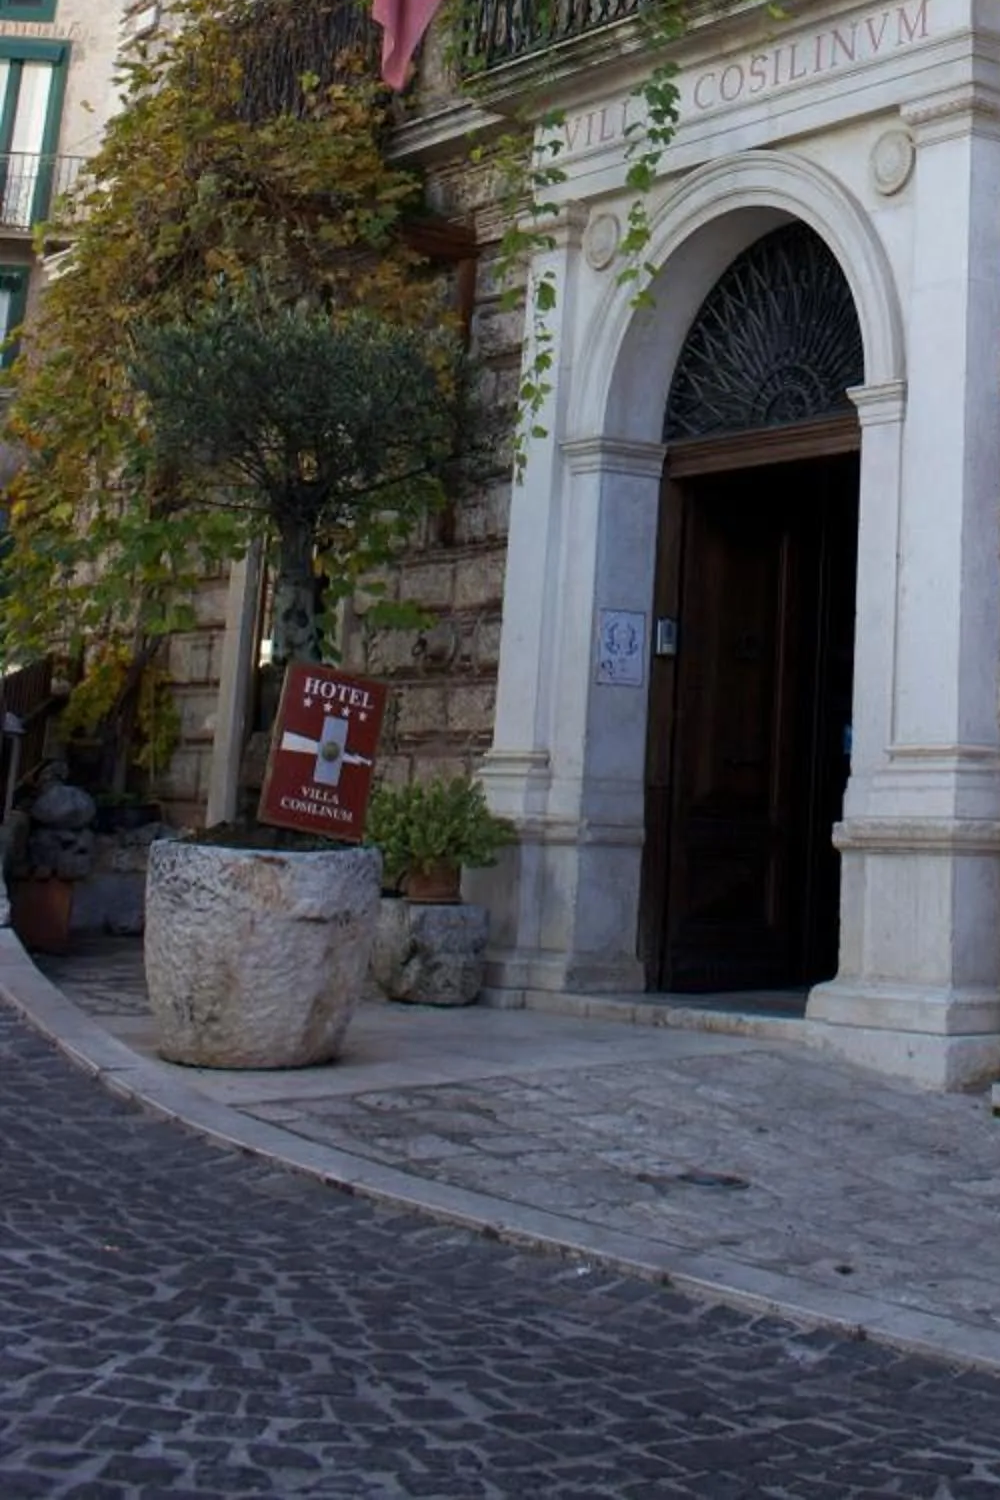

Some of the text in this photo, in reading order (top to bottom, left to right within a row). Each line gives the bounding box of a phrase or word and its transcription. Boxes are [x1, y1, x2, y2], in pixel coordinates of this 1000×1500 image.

[563, 98, 651, 151] VILL
[304, 676, 374, 709] HOTEL
[280, 796, 353, 823] COSILINUM
[301, 785, 339, 805] VILLA
